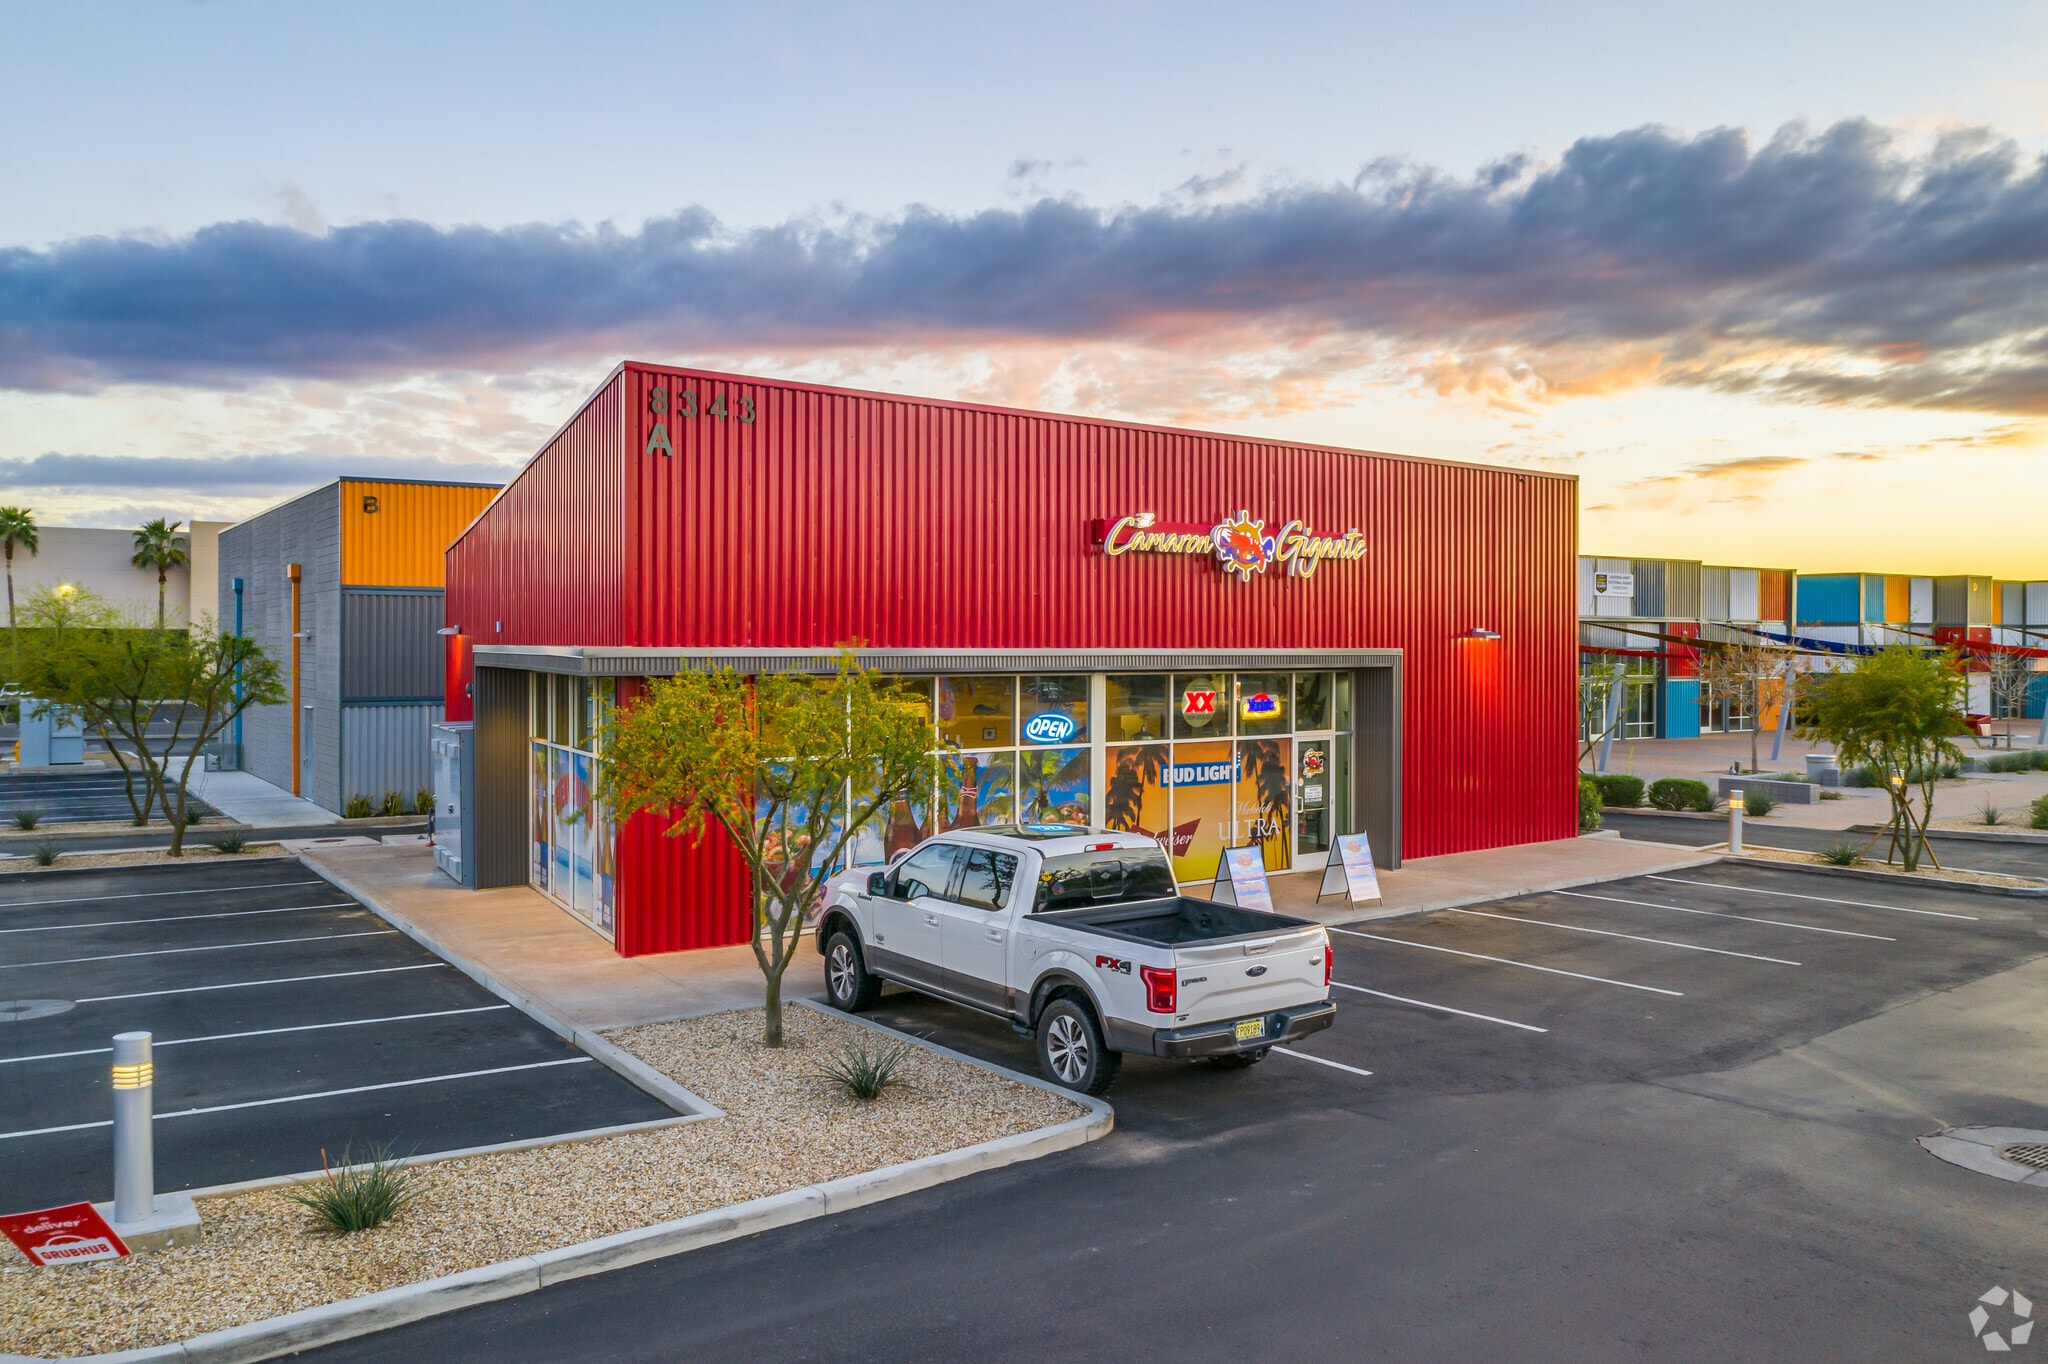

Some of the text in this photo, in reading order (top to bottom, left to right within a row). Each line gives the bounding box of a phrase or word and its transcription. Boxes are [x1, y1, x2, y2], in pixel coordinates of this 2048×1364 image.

[651, 387, 756, 424] 8343
[645, 423, 674, 457] A
[363, 495, 379, 514] B
[1276, 520, 1367, 578] Gigante
[1183, 691, 1216, 713] XX
[1030, 718, 1068, 738] OPEN
[1163, 767, 1195, 784] BUD
[1217, 817, 1280, 841] ULTRA
[1095, 955, 1131, 973] FX4
[23, 1219, 81, 1234] deliver
[41, 1243, 110, 1260] GRUBHUB
